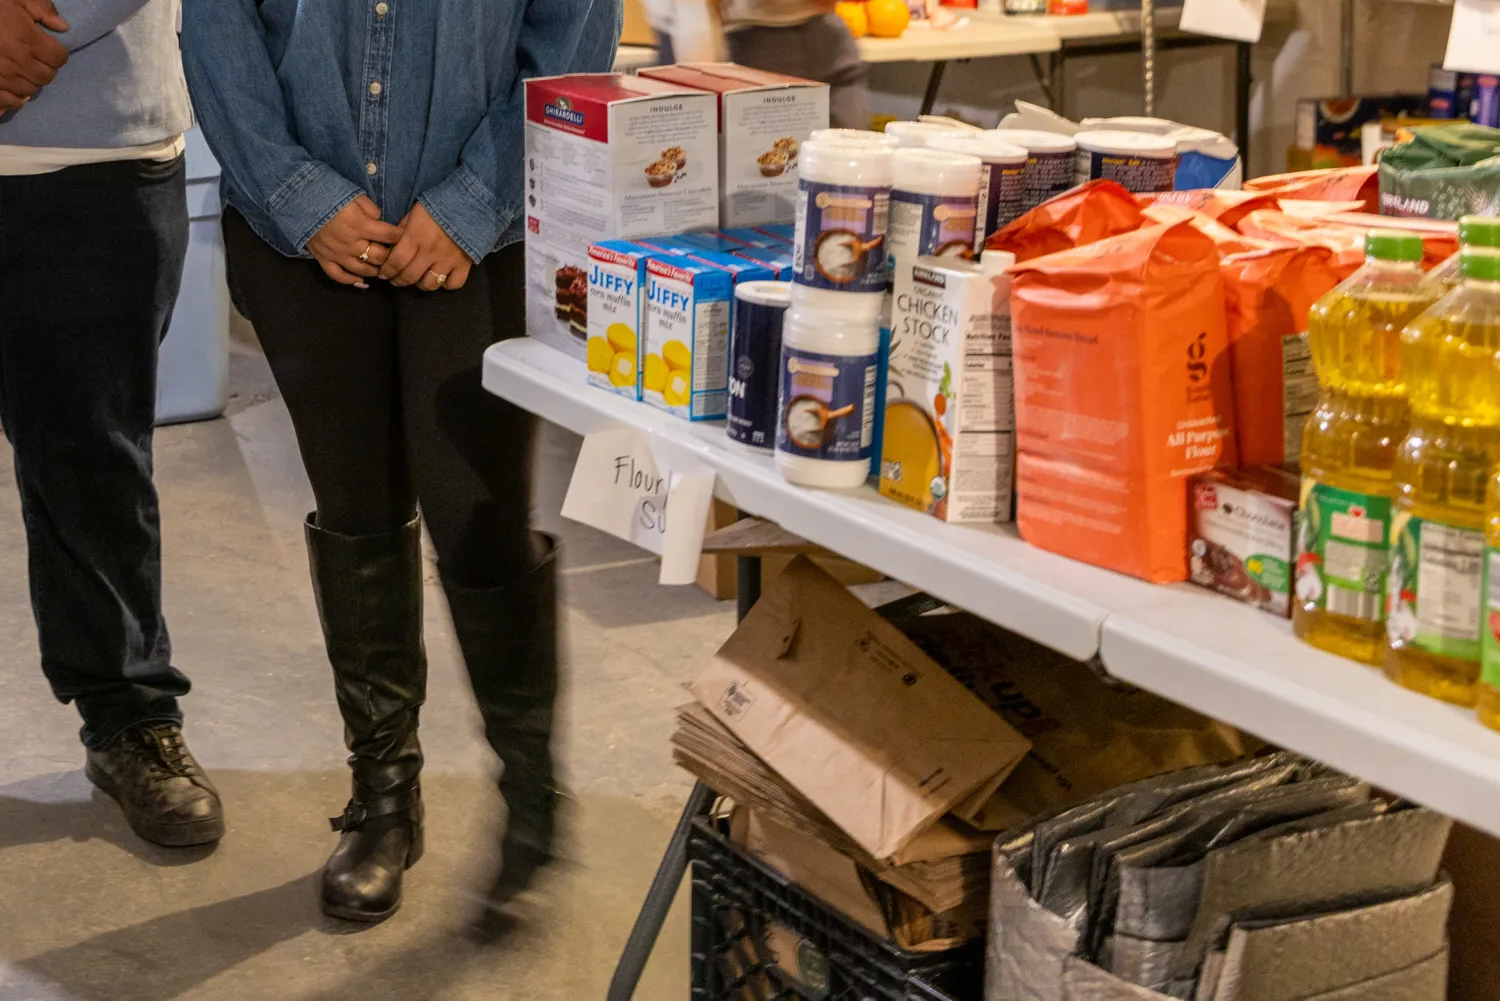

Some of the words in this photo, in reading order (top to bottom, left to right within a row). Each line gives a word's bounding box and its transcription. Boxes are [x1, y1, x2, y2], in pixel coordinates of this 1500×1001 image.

[650, 103, 684, 112] INDULGE
[762, 95, 796, 104] INDULGE
[545, 105, 583, 125] GHIRARDELLI
[589, 246, 614, 261] America's
[613, 254, 635, 268] Favorite
[589, 265, 634, 296] JIFFY
[646, 260, 671, 277] America's
[670, 268, 692, 284] Favorite
[913, 269, 945, 285] KIRKLAND
[590, 288, 605, 298] corn
[606, 292, 631, 308] muffin
[647, 280, 690, 312] JIFFY
[913, 285, 944, 300] ORGANIC
[602, 302, 617, 314] mix
[647, 303, 662, 315] corn
[663, 308, 687, 325] muffin
[897, 293, 959, 326] CHICKEN
[659, 318, 673, 330] mix
[903, 317, 950, 346] STOCK
[965, 332, 995, 341] Nutrition
[1167, 431, 1185, 446] All
[1185, 428, 1230, 444] Purpose
[1185, 445, 1218, 460] Flour
[614, 455, 664, 495] Flour
